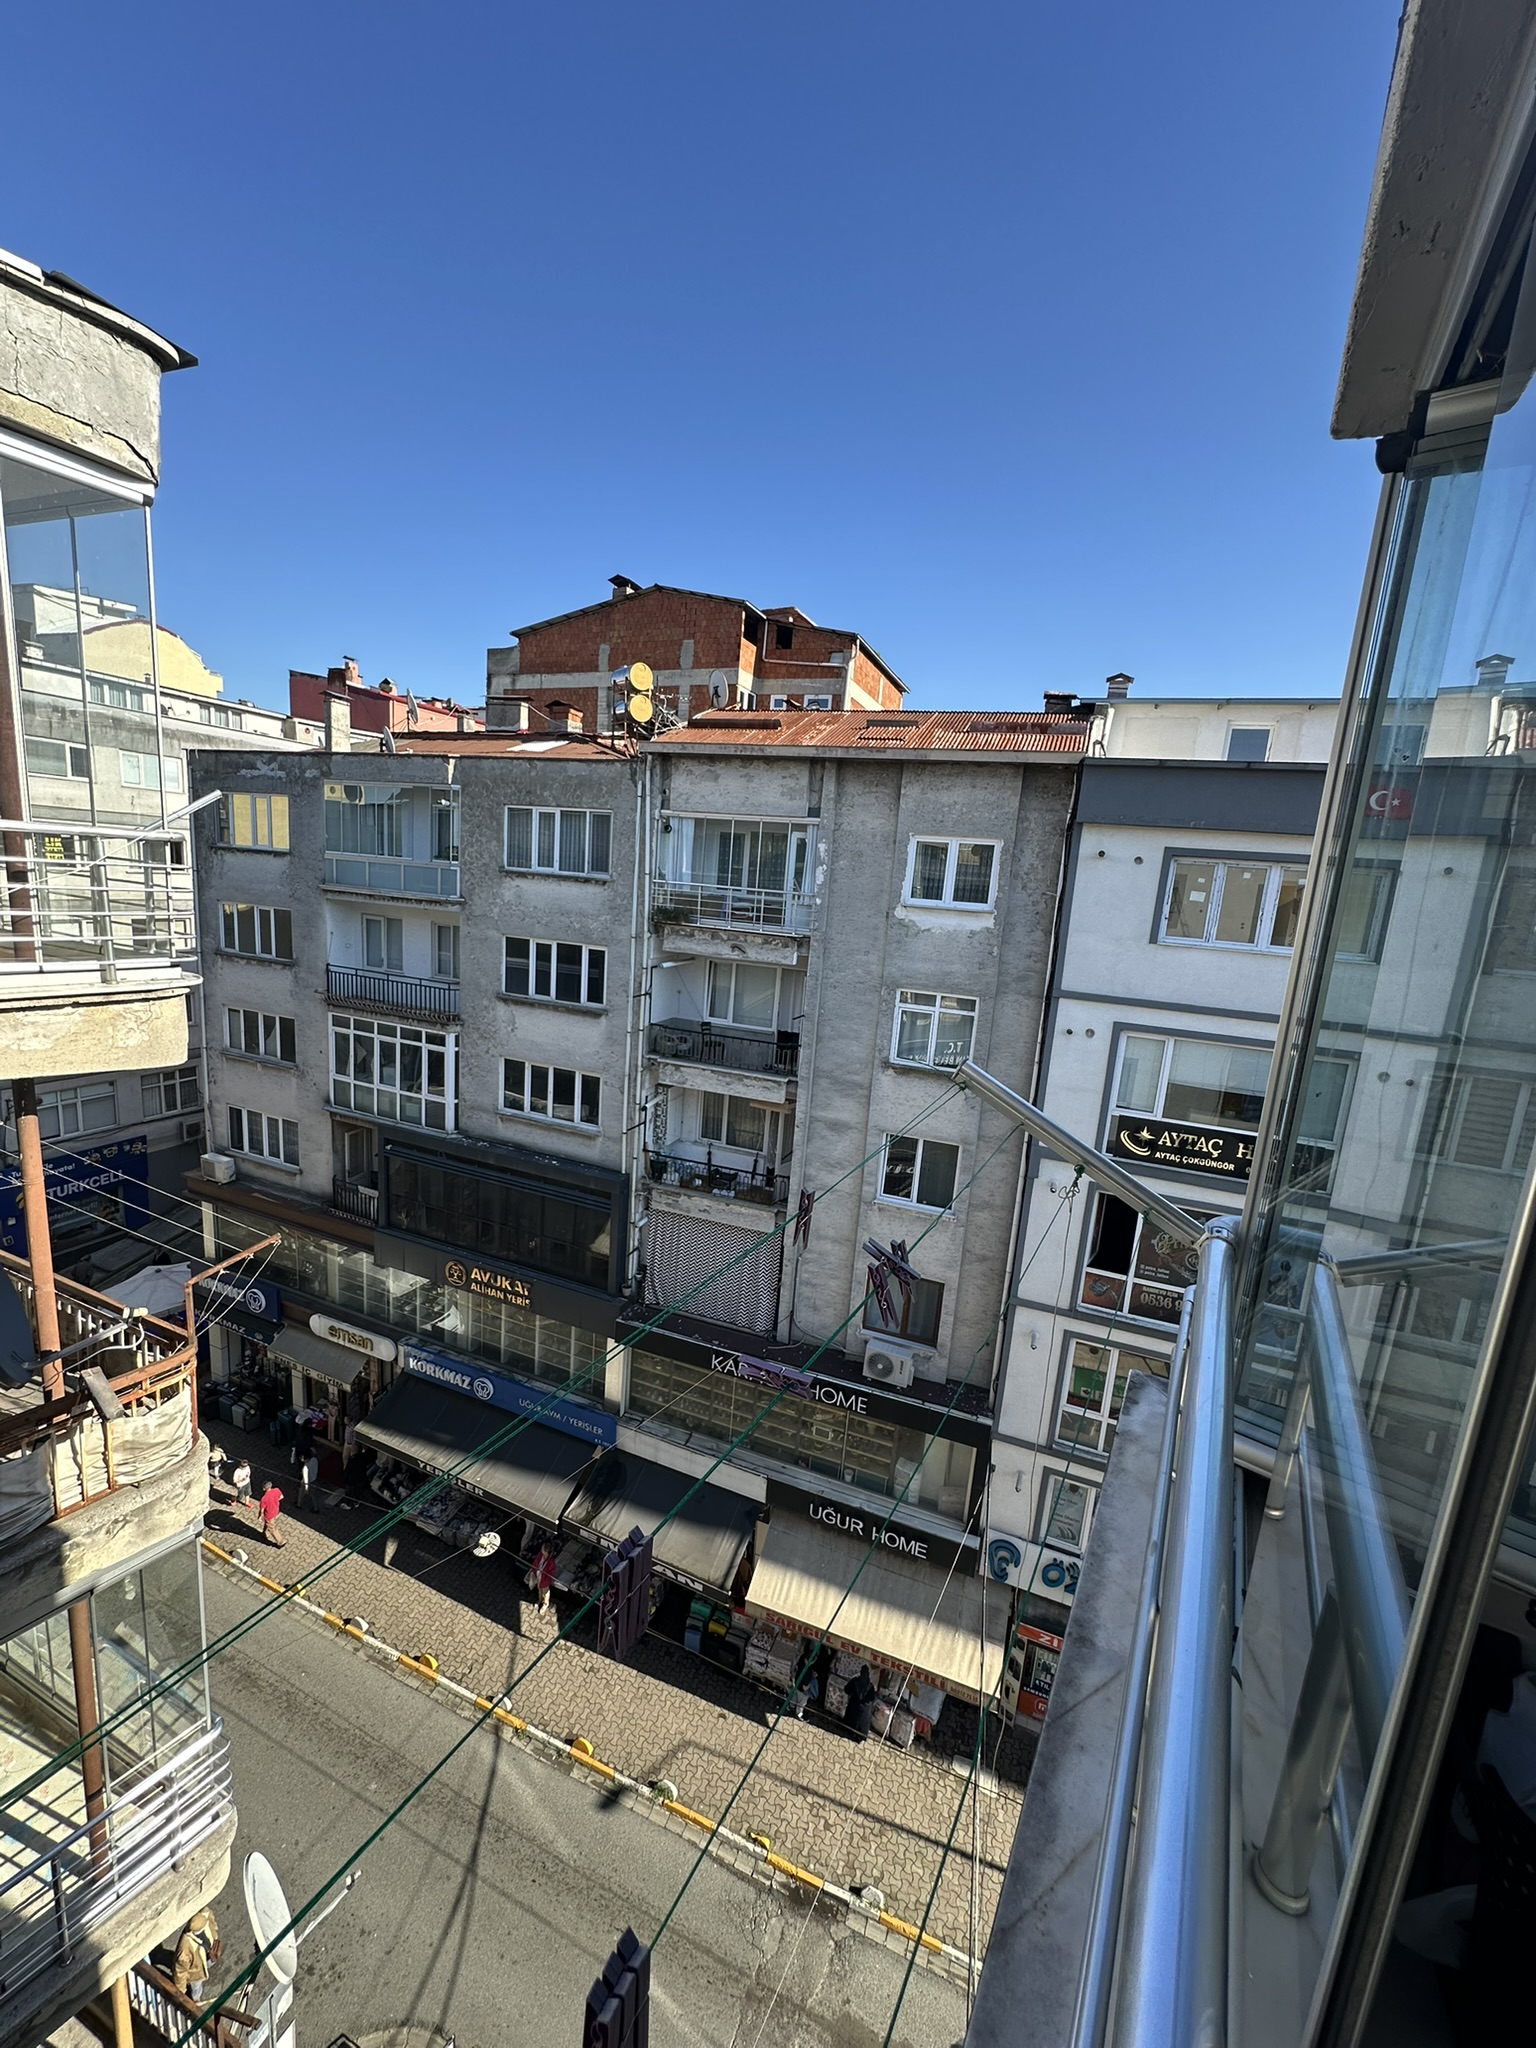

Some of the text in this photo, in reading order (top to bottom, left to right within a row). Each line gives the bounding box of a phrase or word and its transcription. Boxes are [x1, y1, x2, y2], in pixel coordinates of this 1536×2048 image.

[1155, 1151, 1181, 1163] AYTAÇ
[1158, 1130, 1254, 1160] AYTAÇ H
[46, 1169, 126, 1198] TURKCELL
[470, 1267, 532, 1296] AVUKAT
[470, 1282, 504, 1300] ALİHAN
[1140, 1292, 1184, 1312] 0536 9
[328, 1325, 374, 1352] emsan
[409, 1356, 472, 1390] KORKMAZ
[811, 1384, 869, 1415] HOME
[809, 1503, 929, 1560] UĞUR HOME
[840, 1640, 862, 1655] EV
